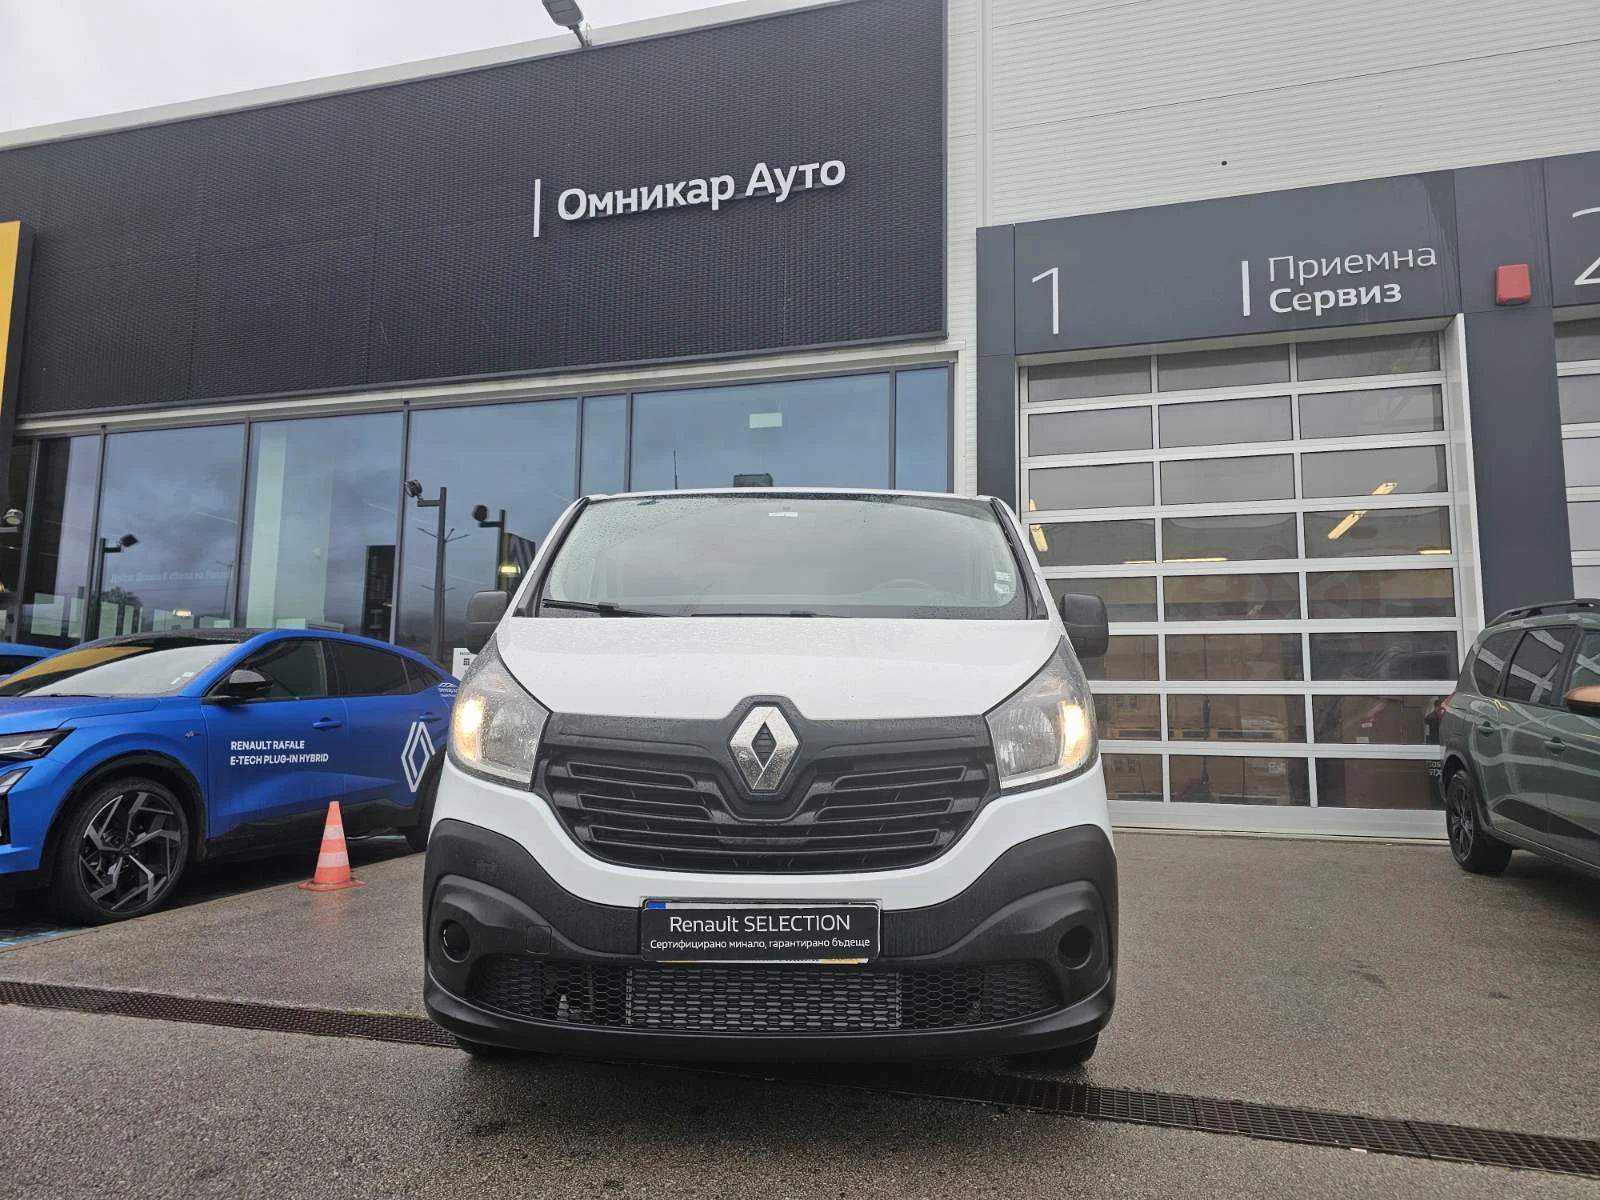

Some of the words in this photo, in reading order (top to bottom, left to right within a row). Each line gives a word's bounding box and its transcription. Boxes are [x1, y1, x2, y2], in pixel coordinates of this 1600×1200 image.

[558, 174, 735, 221] Омникар
[745, 159, 846, 203] Ауто
[1268, 247, 1438, 286] Приемна
[1031, 266, 1060, 335] 1
[1269, 283, 1402, 317] Сервиз
[230, 740, 272, 751] RENAULT
[273, 740, 306, 750] RAFALE
[229, 755, 263, 766] E-TECH
[263, 754, 299, 765] PLUG-IN
[299, 752, 330, 764] HYBRID
[669, 915, 739, 933] Renault
[743, 914, 851, 932] SELECTION
[649, 939, 727, 951] Сертифицирано
[728, 940, 767, 950] минало,
[768, 939, 830, 950] гарантирано
[831, 936, 871, 949] бъдеще
